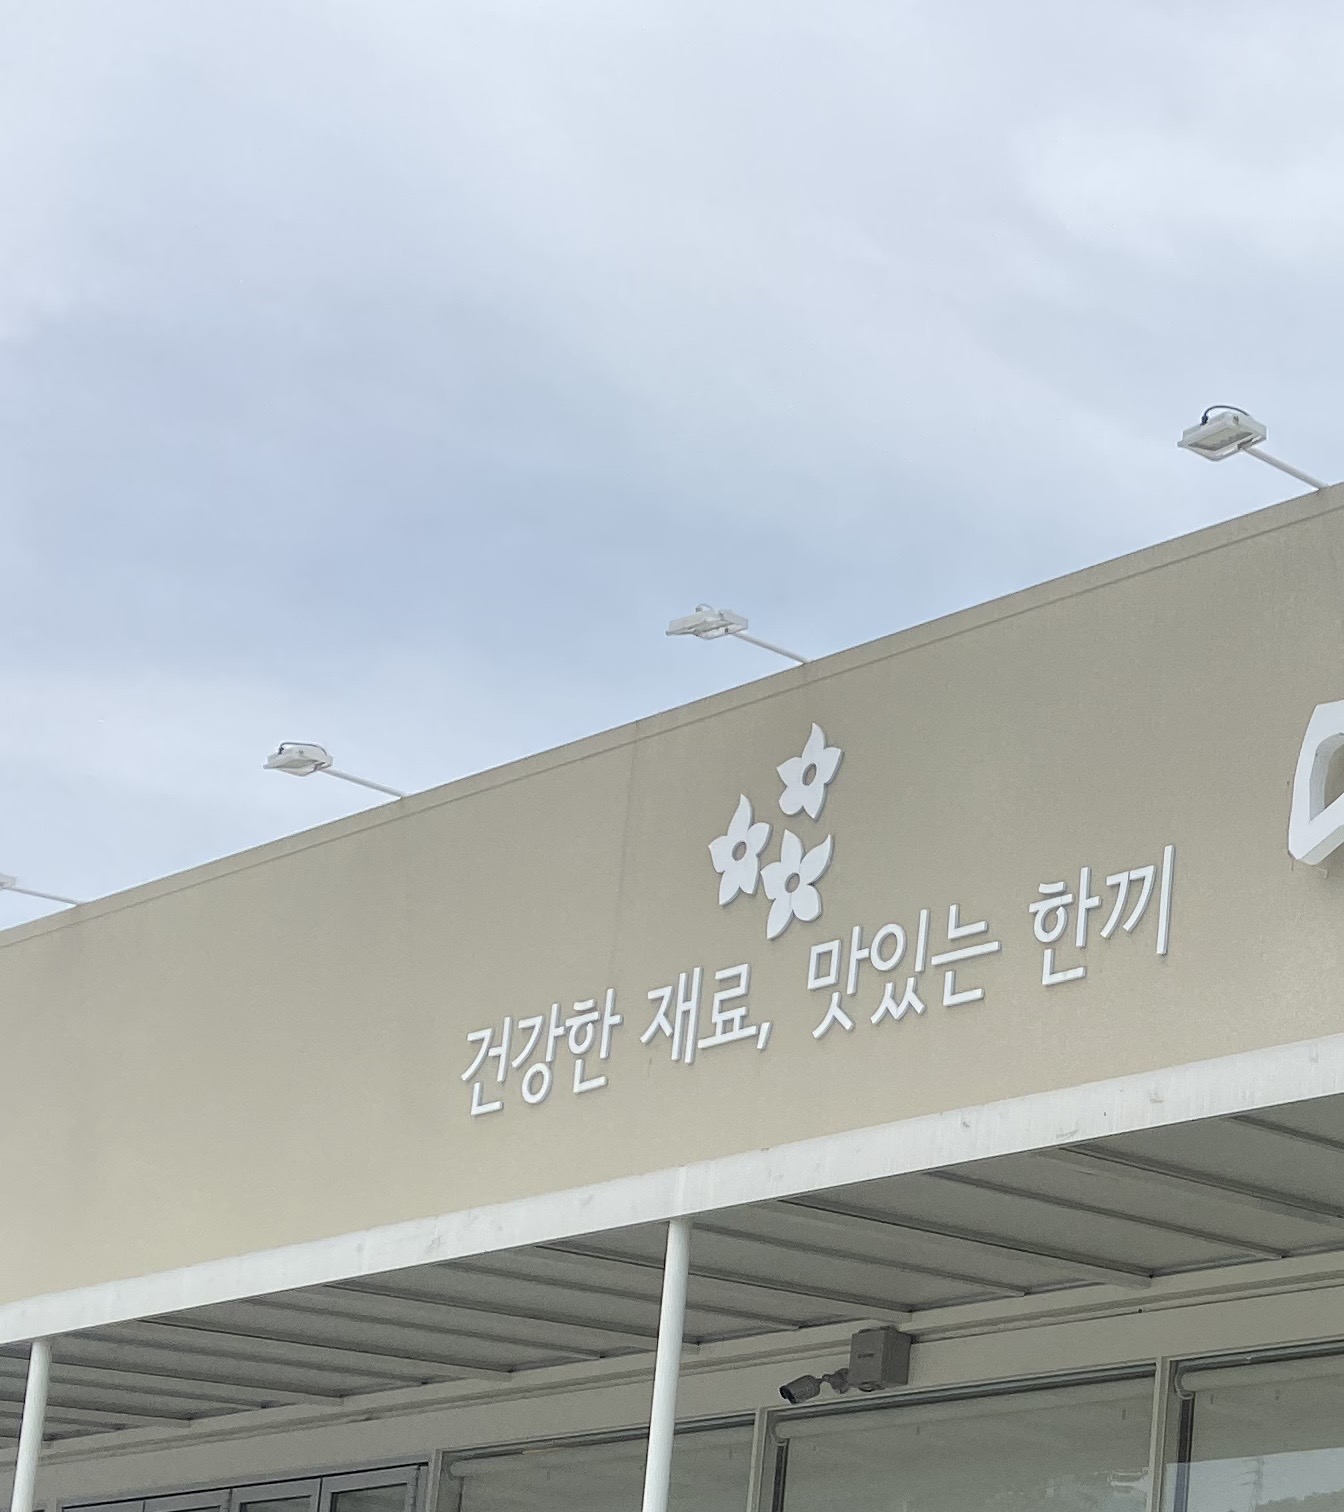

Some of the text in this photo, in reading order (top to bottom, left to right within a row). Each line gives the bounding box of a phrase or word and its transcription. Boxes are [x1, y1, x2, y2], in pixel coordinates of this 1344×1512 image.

[461, 845, 1176, 1117] 건강한 재료, 맛있는 한끼
